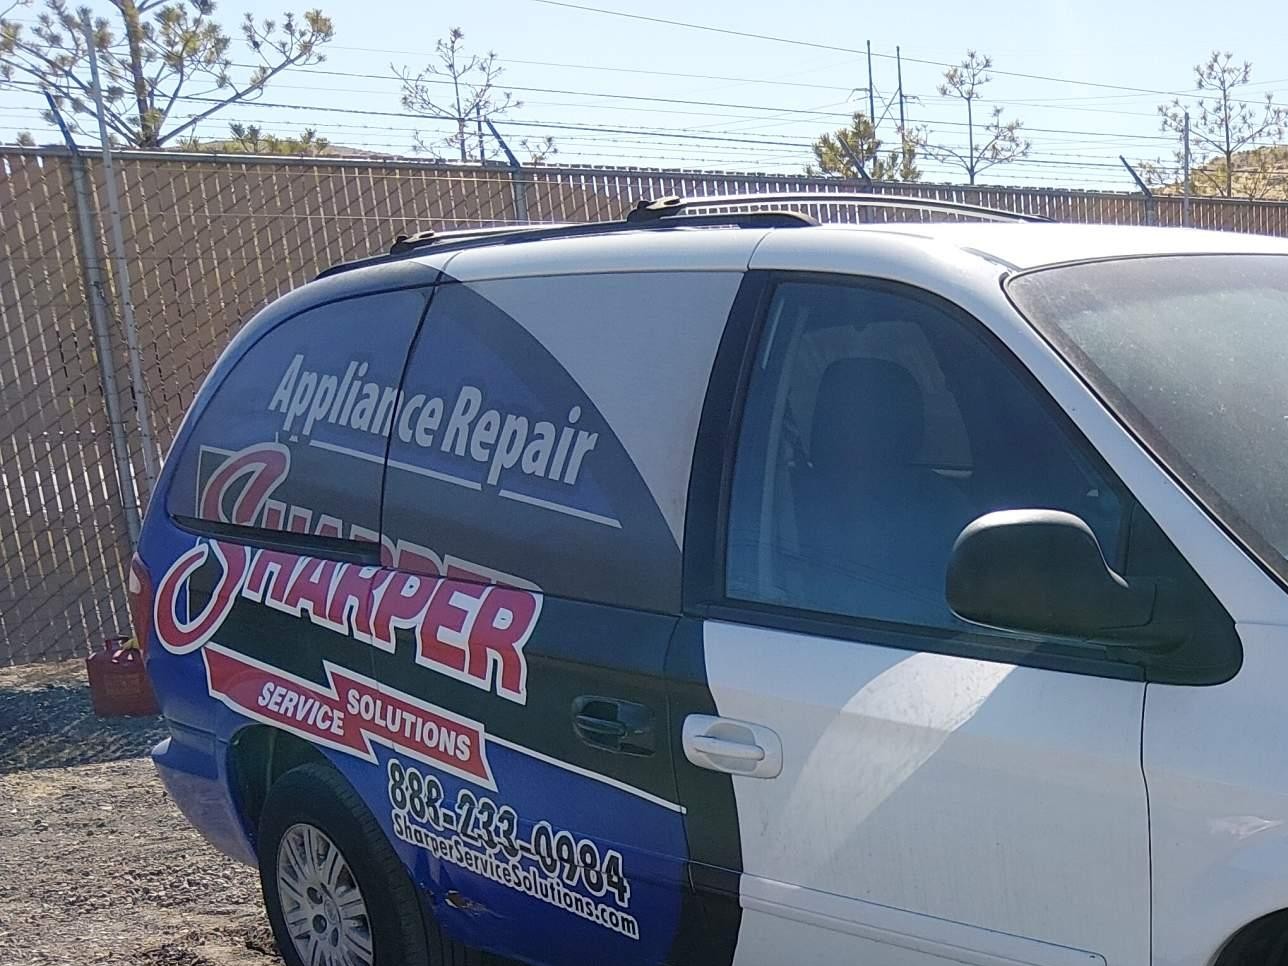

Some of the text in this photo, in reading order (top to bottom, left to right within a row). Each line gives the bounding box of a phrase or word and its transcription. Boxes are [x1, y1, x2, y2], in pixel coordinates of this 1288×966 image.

[268, 353, 600, 486] Appliance Repair
[153, 442, 544, 706] SHARPER
[257, 681, 346, 737] SERVICE
[346, 688, 472, 762] SOLUTIONS
[388, 758, 632, 908] 888-233-0984
[392, 810, 640, 940] SharperServiceSolutions.com
